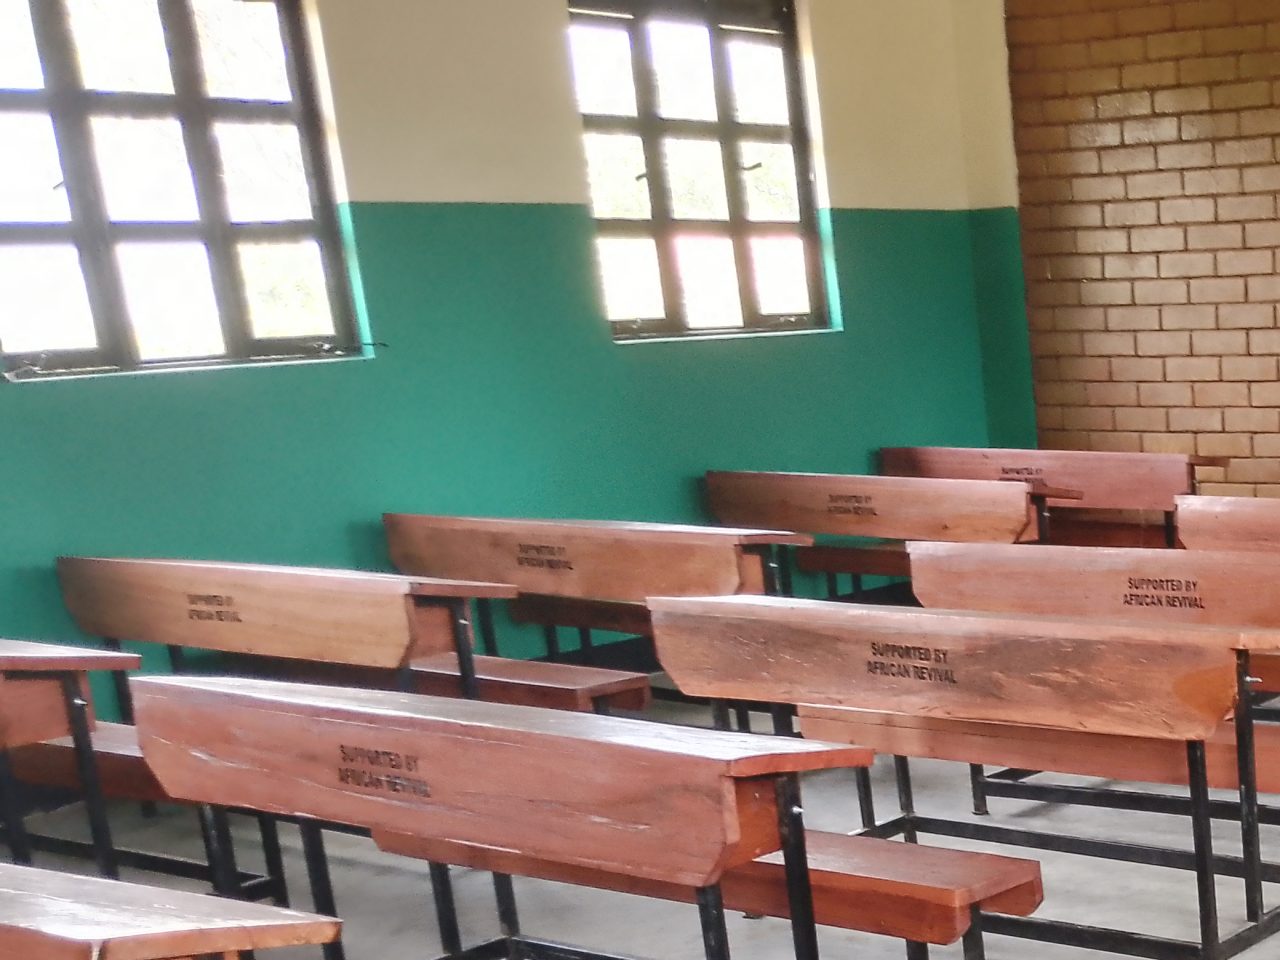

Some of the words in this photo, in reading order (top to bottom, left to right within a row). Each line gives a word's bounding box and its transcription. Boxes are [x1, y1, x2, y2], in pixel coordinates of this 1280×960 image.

[1127, 577, 1183, 591] SUPPORTED
[1185, 580, 1198, 592] BY
[1123, 594, 1163, 606] AFRICAN
[1165, 595, 1205, 609] REVIVAL
[872, 642, 930, 661] SUPPORTED
[933, 649, 948, 663] BY
[867, 660, 911, 678] AFRICAN
[912, 665, 958, 684] REVIVAL
